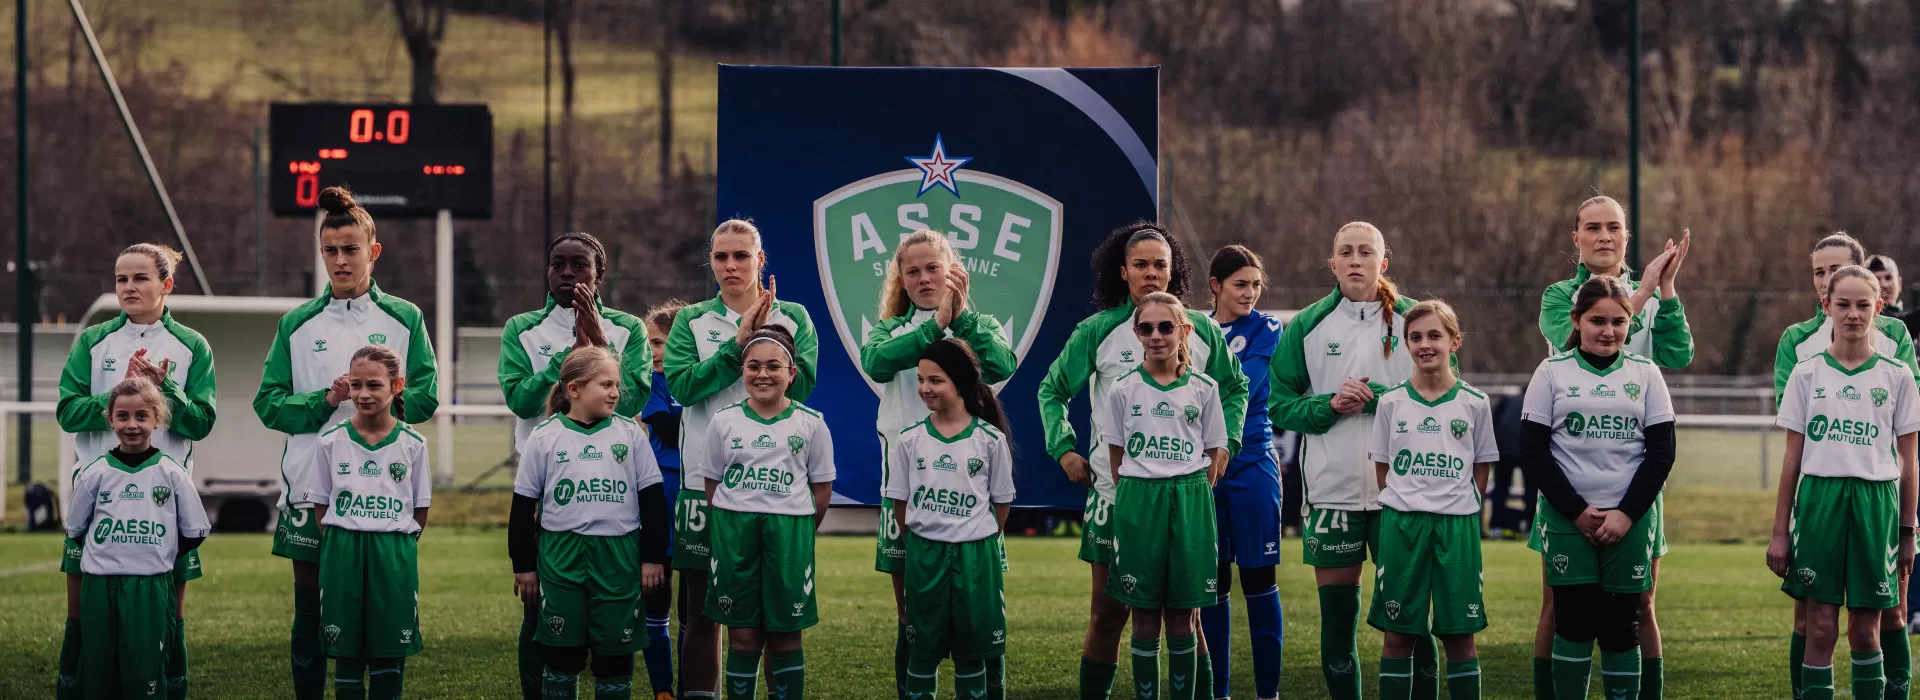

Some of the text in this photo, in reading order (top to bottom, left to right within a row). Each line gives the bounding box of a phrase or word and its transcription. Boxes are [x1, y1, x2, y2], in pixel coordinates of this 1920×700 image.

[296, 175, 319, 207] 0
[851, 203, 1031, 261] ASSE
[1587, 414, 1638, 431] AÉSIO
[1829, 418, 1879, 439] AÉSIO
[1586, 430, 1635, 440] MUTUELLE
[1146, 435, 1194, 455] AÉSIO
[1412, 452, 1464, 471] AÉSIO
[744, 466, 794, 486] AÉSIO
[1411, 467, 1460, 480] MUTUELLE
[576, 477, 627, 494] AÉSIO
[742, 481, 792, 494] MUTUELLE
[352, 494, 403, 513] AÉSIO
[576, 494, 625, 504] MUTUELLE
[923, 487, 977, 509] AÉSIO
[683, 499, 708, 532] 15
[921, 502, 972, 518] MUTUELLE
[112, 518, 166, 537] AÉSIO
[882, 506, 900, 540] 18
[1313, 508, 1349, 533] 24
